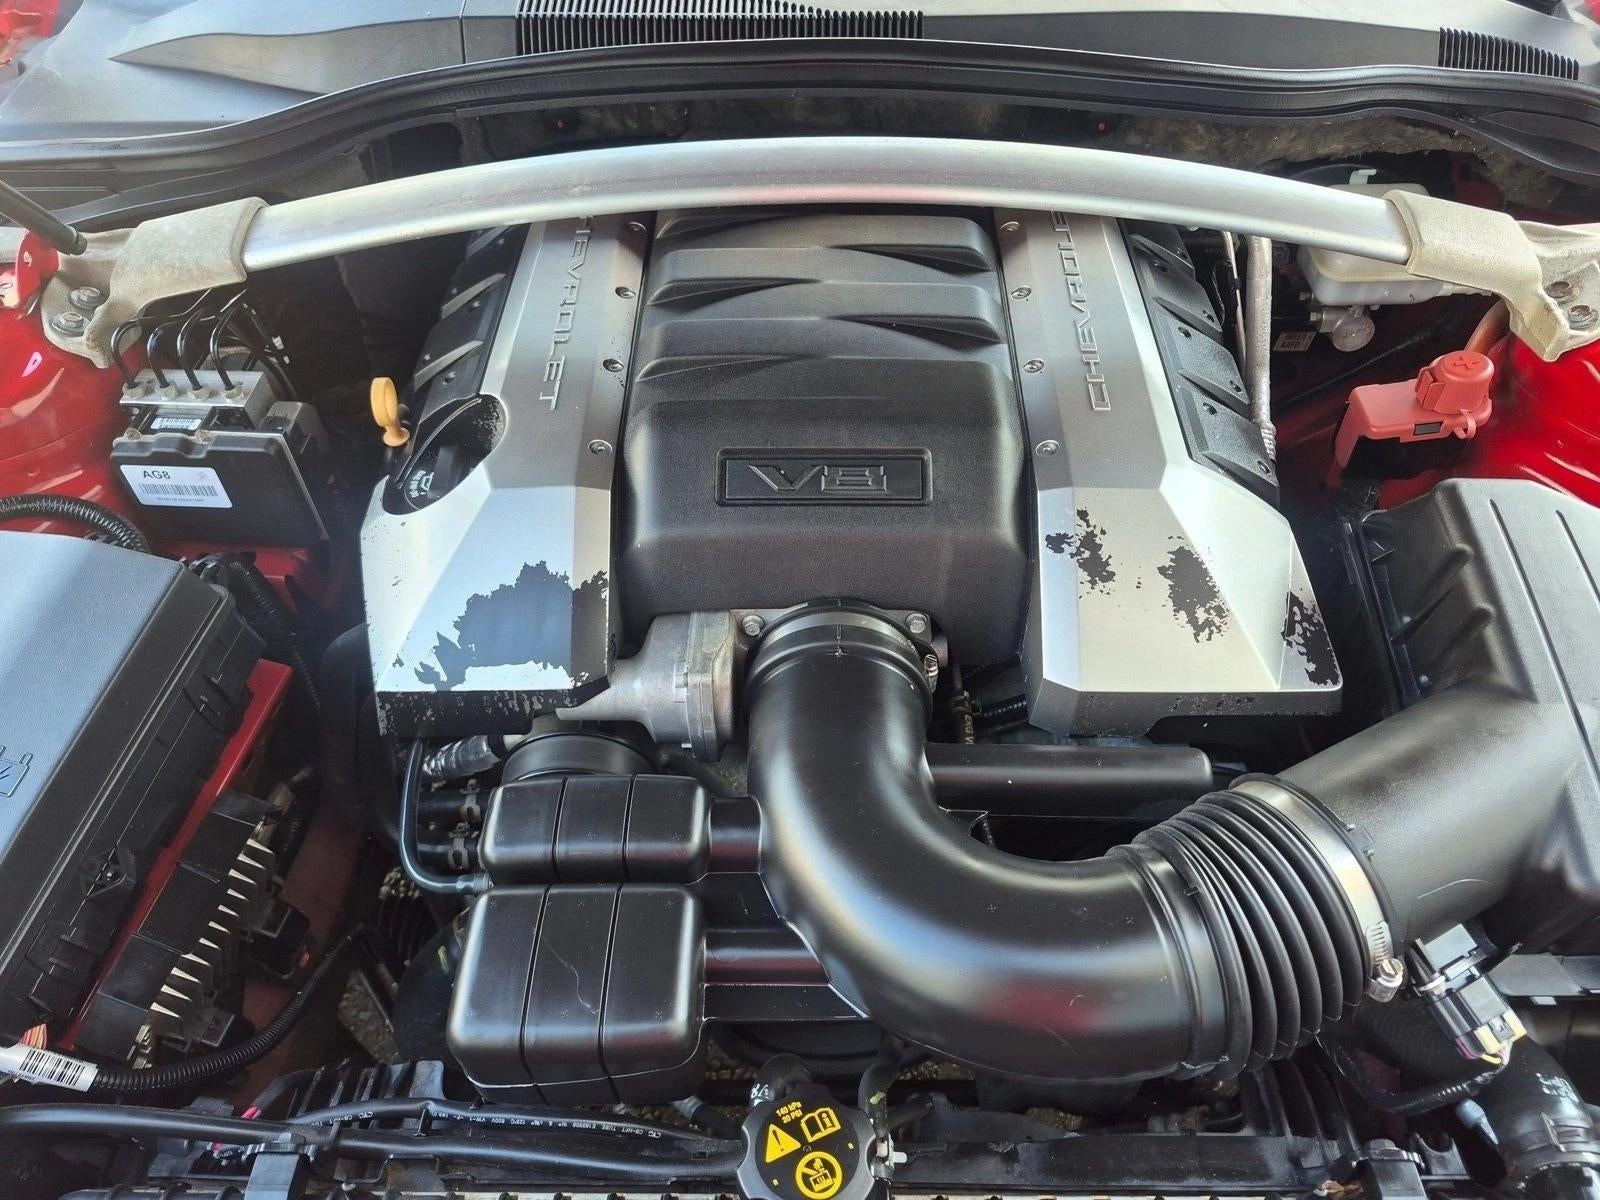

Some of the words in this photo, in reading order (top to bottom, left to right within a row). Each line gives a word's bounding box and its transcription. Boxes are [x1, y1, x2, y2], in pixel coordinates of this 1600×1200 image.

[539, 216, 594, 410] HEVROLET
[1051, 211, 1112, 411] CHEVROLE
[143, 469, 171, 480] AG8
[748, 465, 887, 493] V8
[776, 1106, 789, 1117] 140
[782, 1114, 791, 1123] 20
